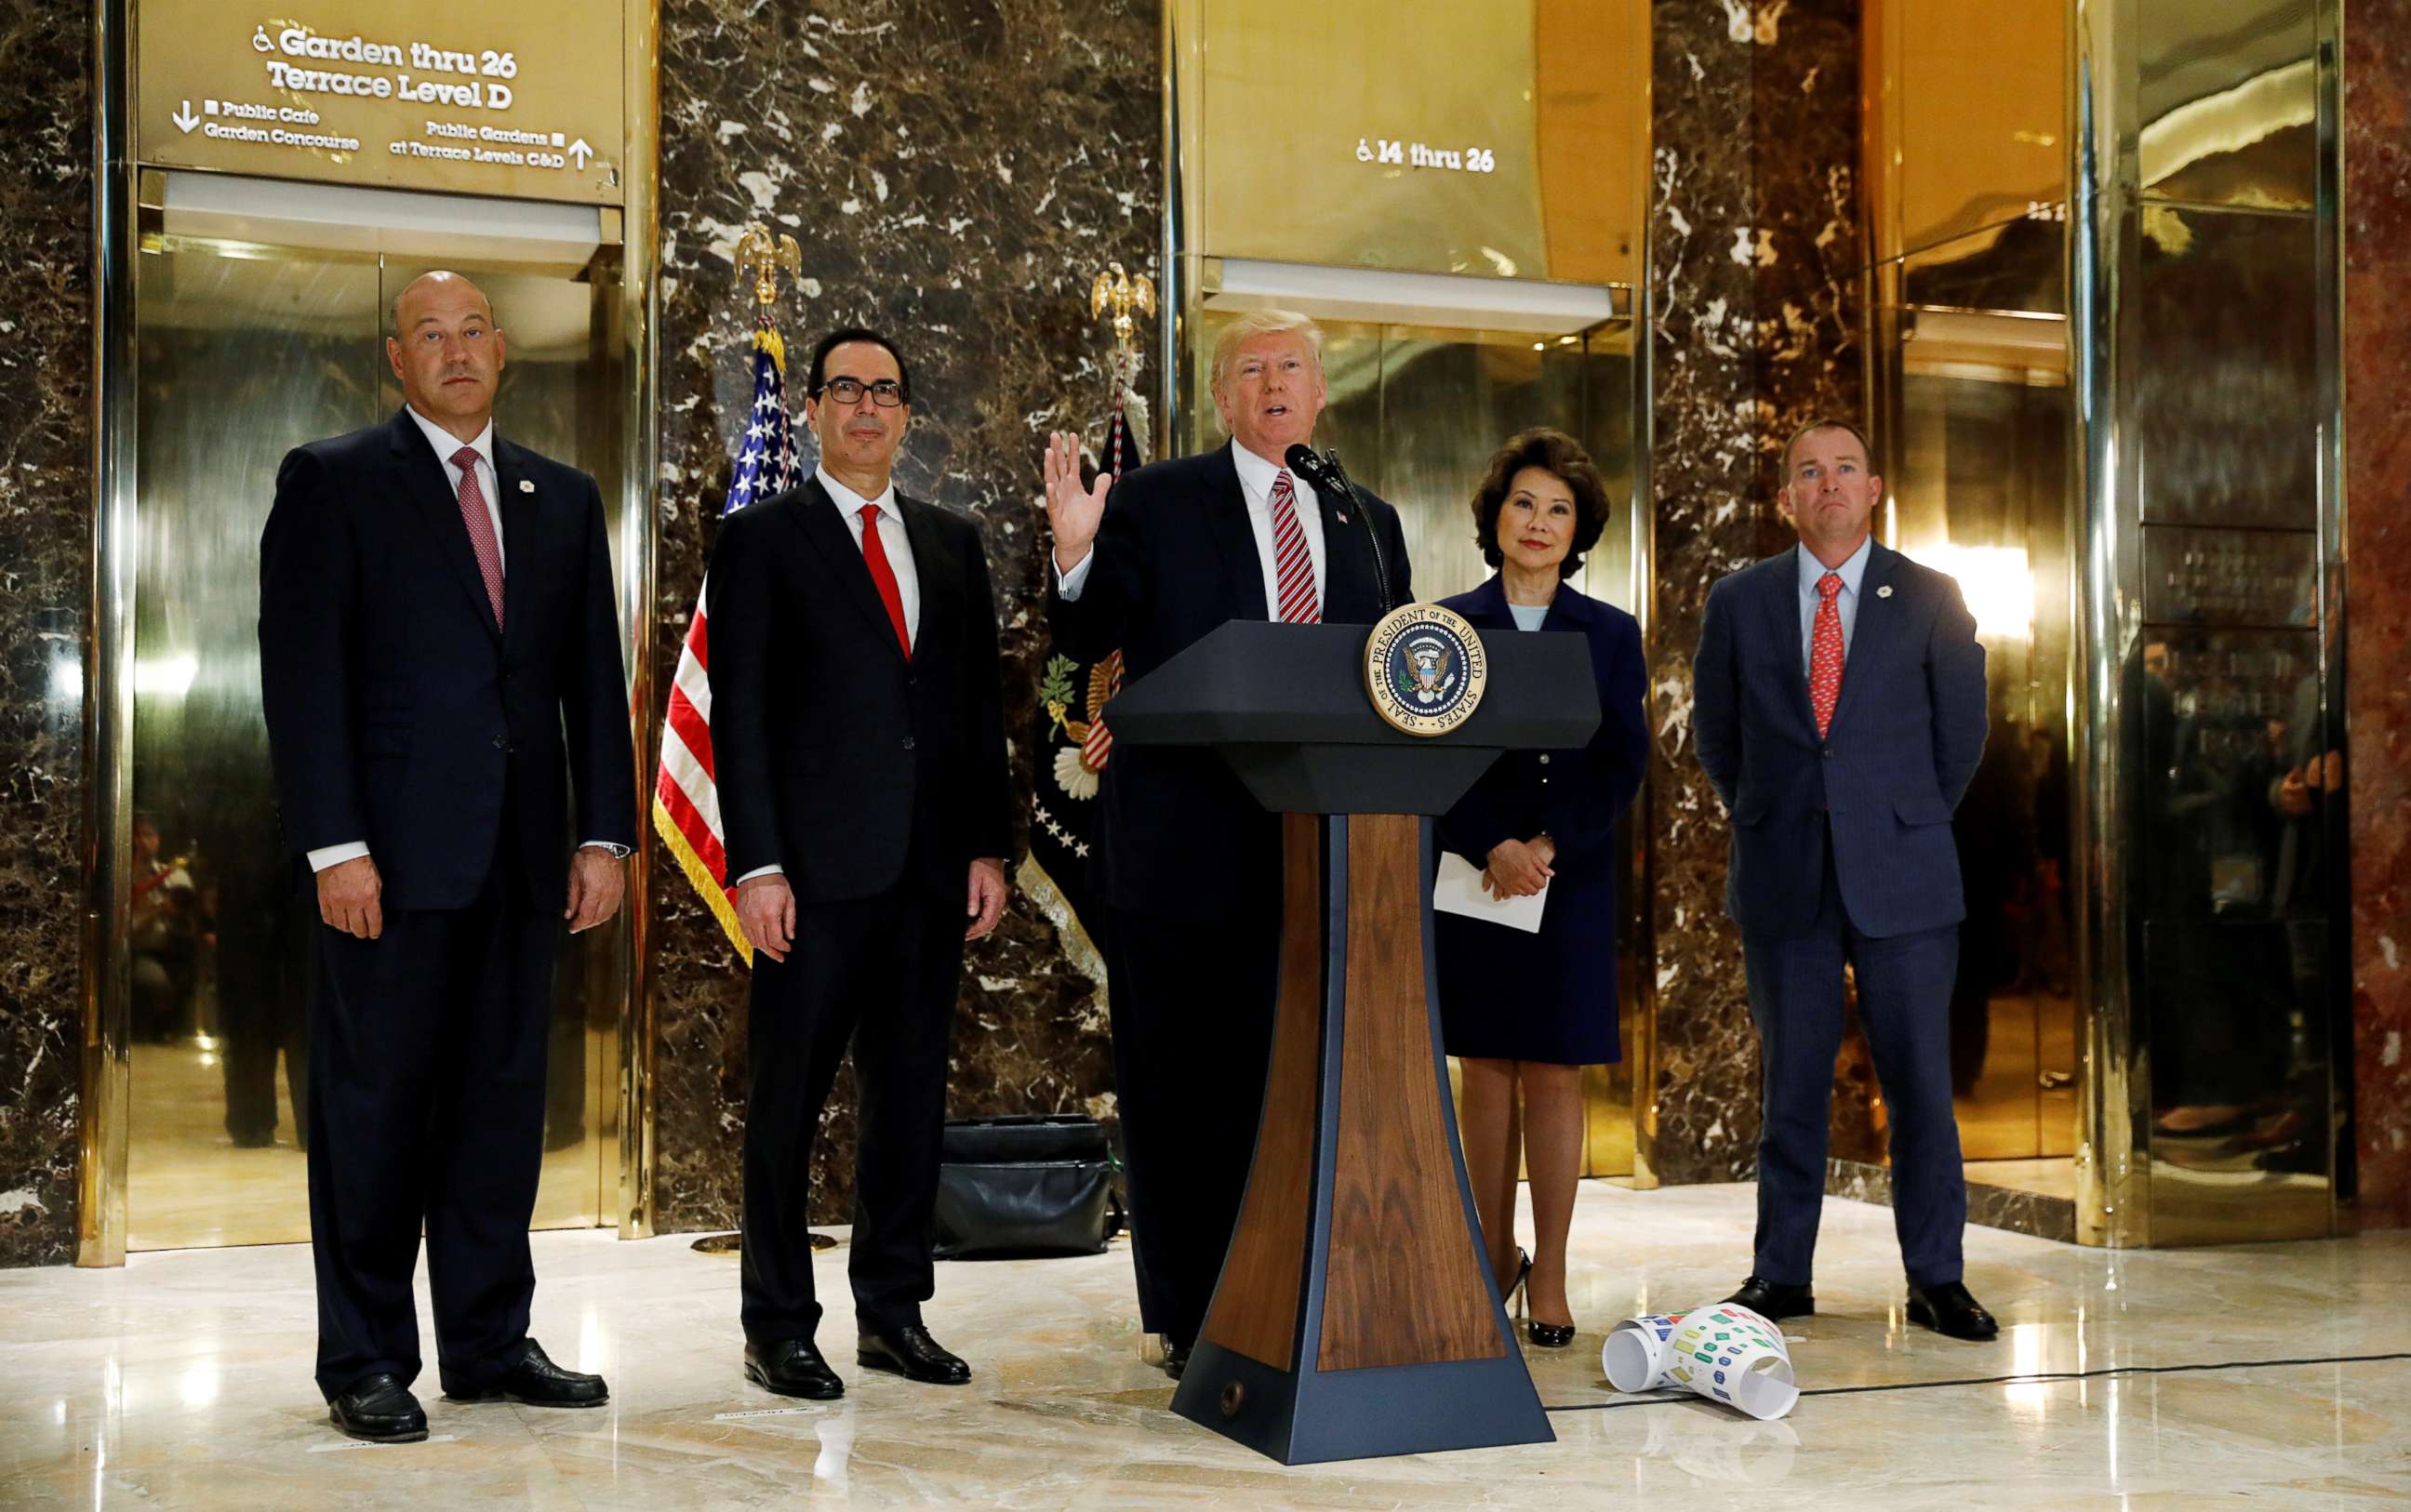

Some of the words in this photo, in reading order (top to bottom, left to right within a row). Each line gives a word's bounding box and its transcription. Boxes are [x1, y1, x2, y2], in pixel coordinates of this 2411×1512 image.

[279, 28, 403, 66] Garden
[410, 42, 476, 74] thru
[481, 50, 517, 79] 26
[266, 60, 392, 98] Terrace
[397, 74, 482, 107] Level
[487, 84, 513, 110] D
[222, 101, 277, 121] Public
[279, 107, 320, 125] Cafe
[204, 122, 269, 142] Garden
[271, 128, 360, 151] Concourse
[426, 121, 477, 139] Public
[480, 126, 548, 146] Gardens
[390, 140, 406, 155] at
[409, 141, 471, 161] Terrace
[473, 147, 524, 165] Levels
[526, 153, 565, 168] C&D
[1378, 139, 1404, 165] 14
[1409, 142, 1461, 170] thru
[1466, 147, 1495, 173] 26
[1429, 611, 1440, 620] OF
[1443, 615, 1457, 628] THE
[1373, 609, 1426, 664] PRESIDENT
[1459, 626, 1483, 679] UNITED
[1374, 670, 1383, 685] THE
[1379, 688, 1388, 700] OF
[1388, 699, 1417, 726] SEAL
[1437, 690, 1477, 728] STATES
